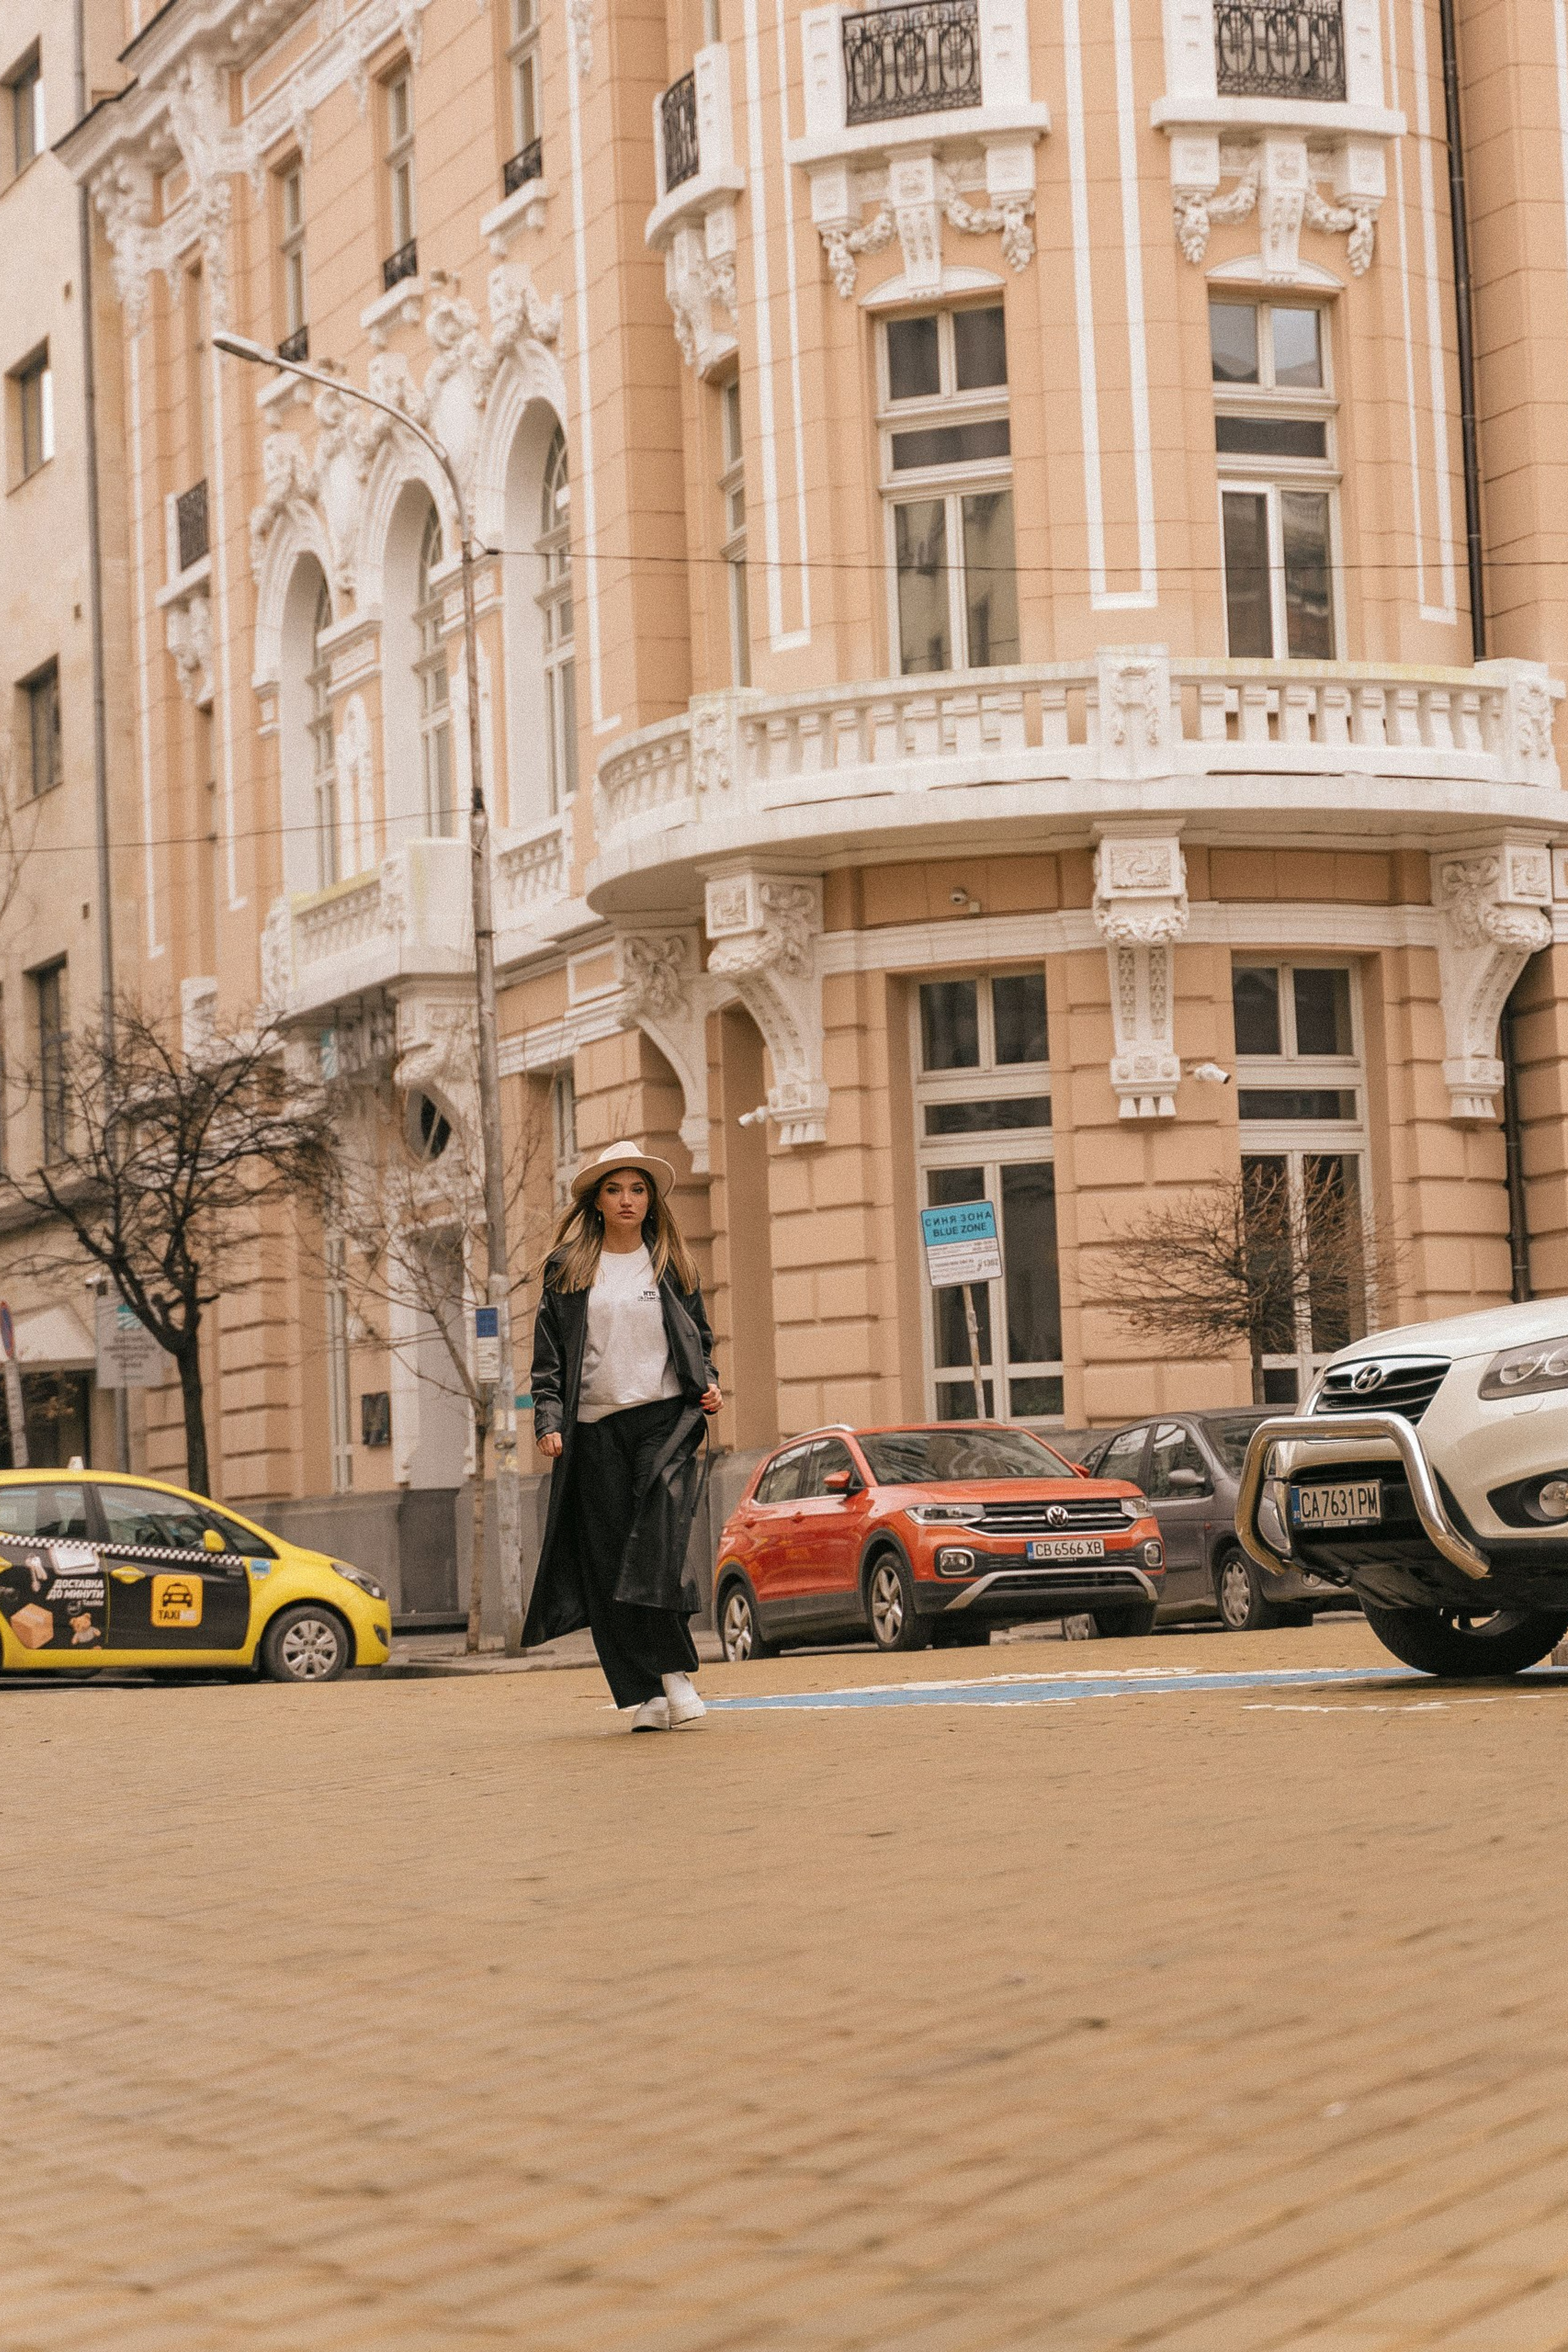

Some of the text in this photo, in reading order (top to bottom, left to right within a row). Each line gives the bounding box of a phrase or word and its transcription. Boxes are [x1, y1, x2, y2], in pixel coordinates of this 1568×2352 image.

[925, 1211, 992, 1227] СИНЯ ЗОНА
[933, 1222, 987, 1237] BLUE ZONE
[1300, 1491, 1320, 1518] CA
[1322, 1488, 1355, 1517] 7631
[1358, 1487, 1378, 1515] PM
[1035, 1541, 1102, 1557] CB 6566 XB
[52, 1578, 104, 1589] ДОСТАВКА
[46, 1589, 105, 1600] ДО МИНУТИ
